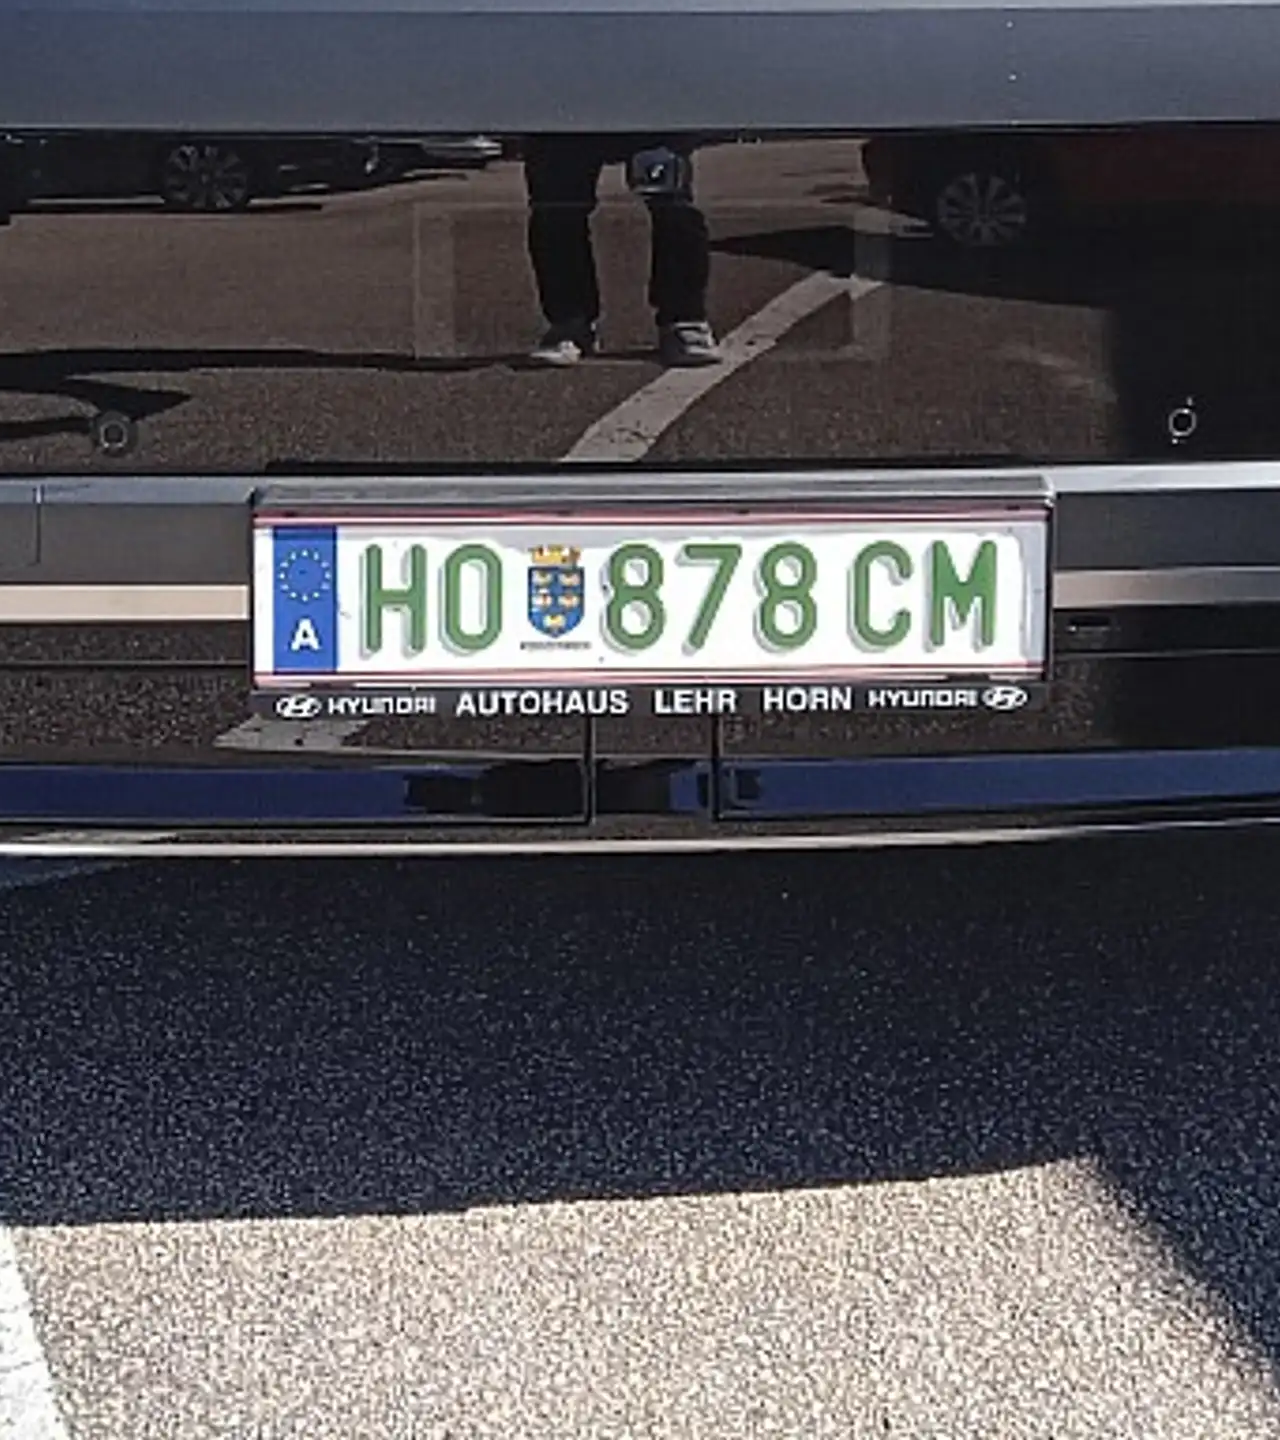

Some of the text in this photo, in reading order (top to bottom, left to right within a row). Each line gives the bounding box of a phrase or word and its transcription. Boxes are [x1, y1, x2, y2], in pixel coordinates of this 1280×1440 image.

[363, 539, 998, 653] HO 878 CM
[290, 618, 320, 651] A
[327, 686, 977, 715] HYUNDAI AUTOHAUS LEHR HORN HYUNDAI
